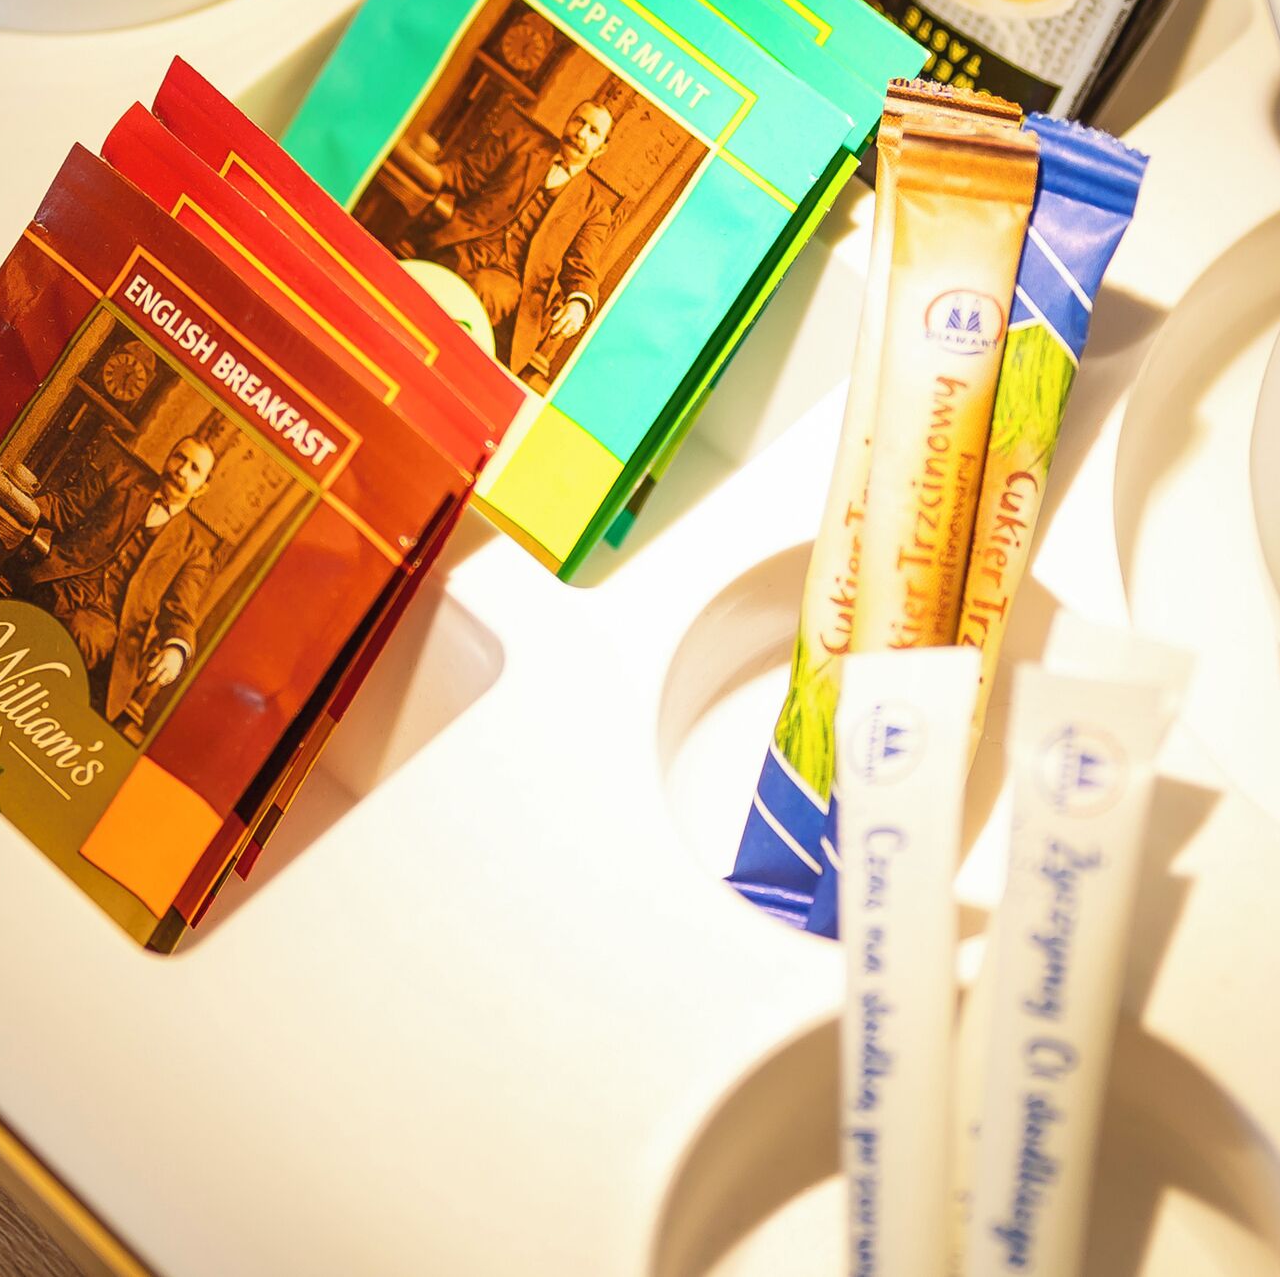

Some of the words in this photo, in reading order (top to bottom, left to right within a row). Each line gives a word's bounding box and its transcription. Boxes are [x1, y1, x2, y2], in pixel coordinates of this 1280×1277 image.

[123, 273, 216, 366] ENGLISH
[210, 348, 340, 467] BREAKFAST
[898, 375, 968, 573] Trzcinowy
[981, 469, 1039, 588] Cukier
